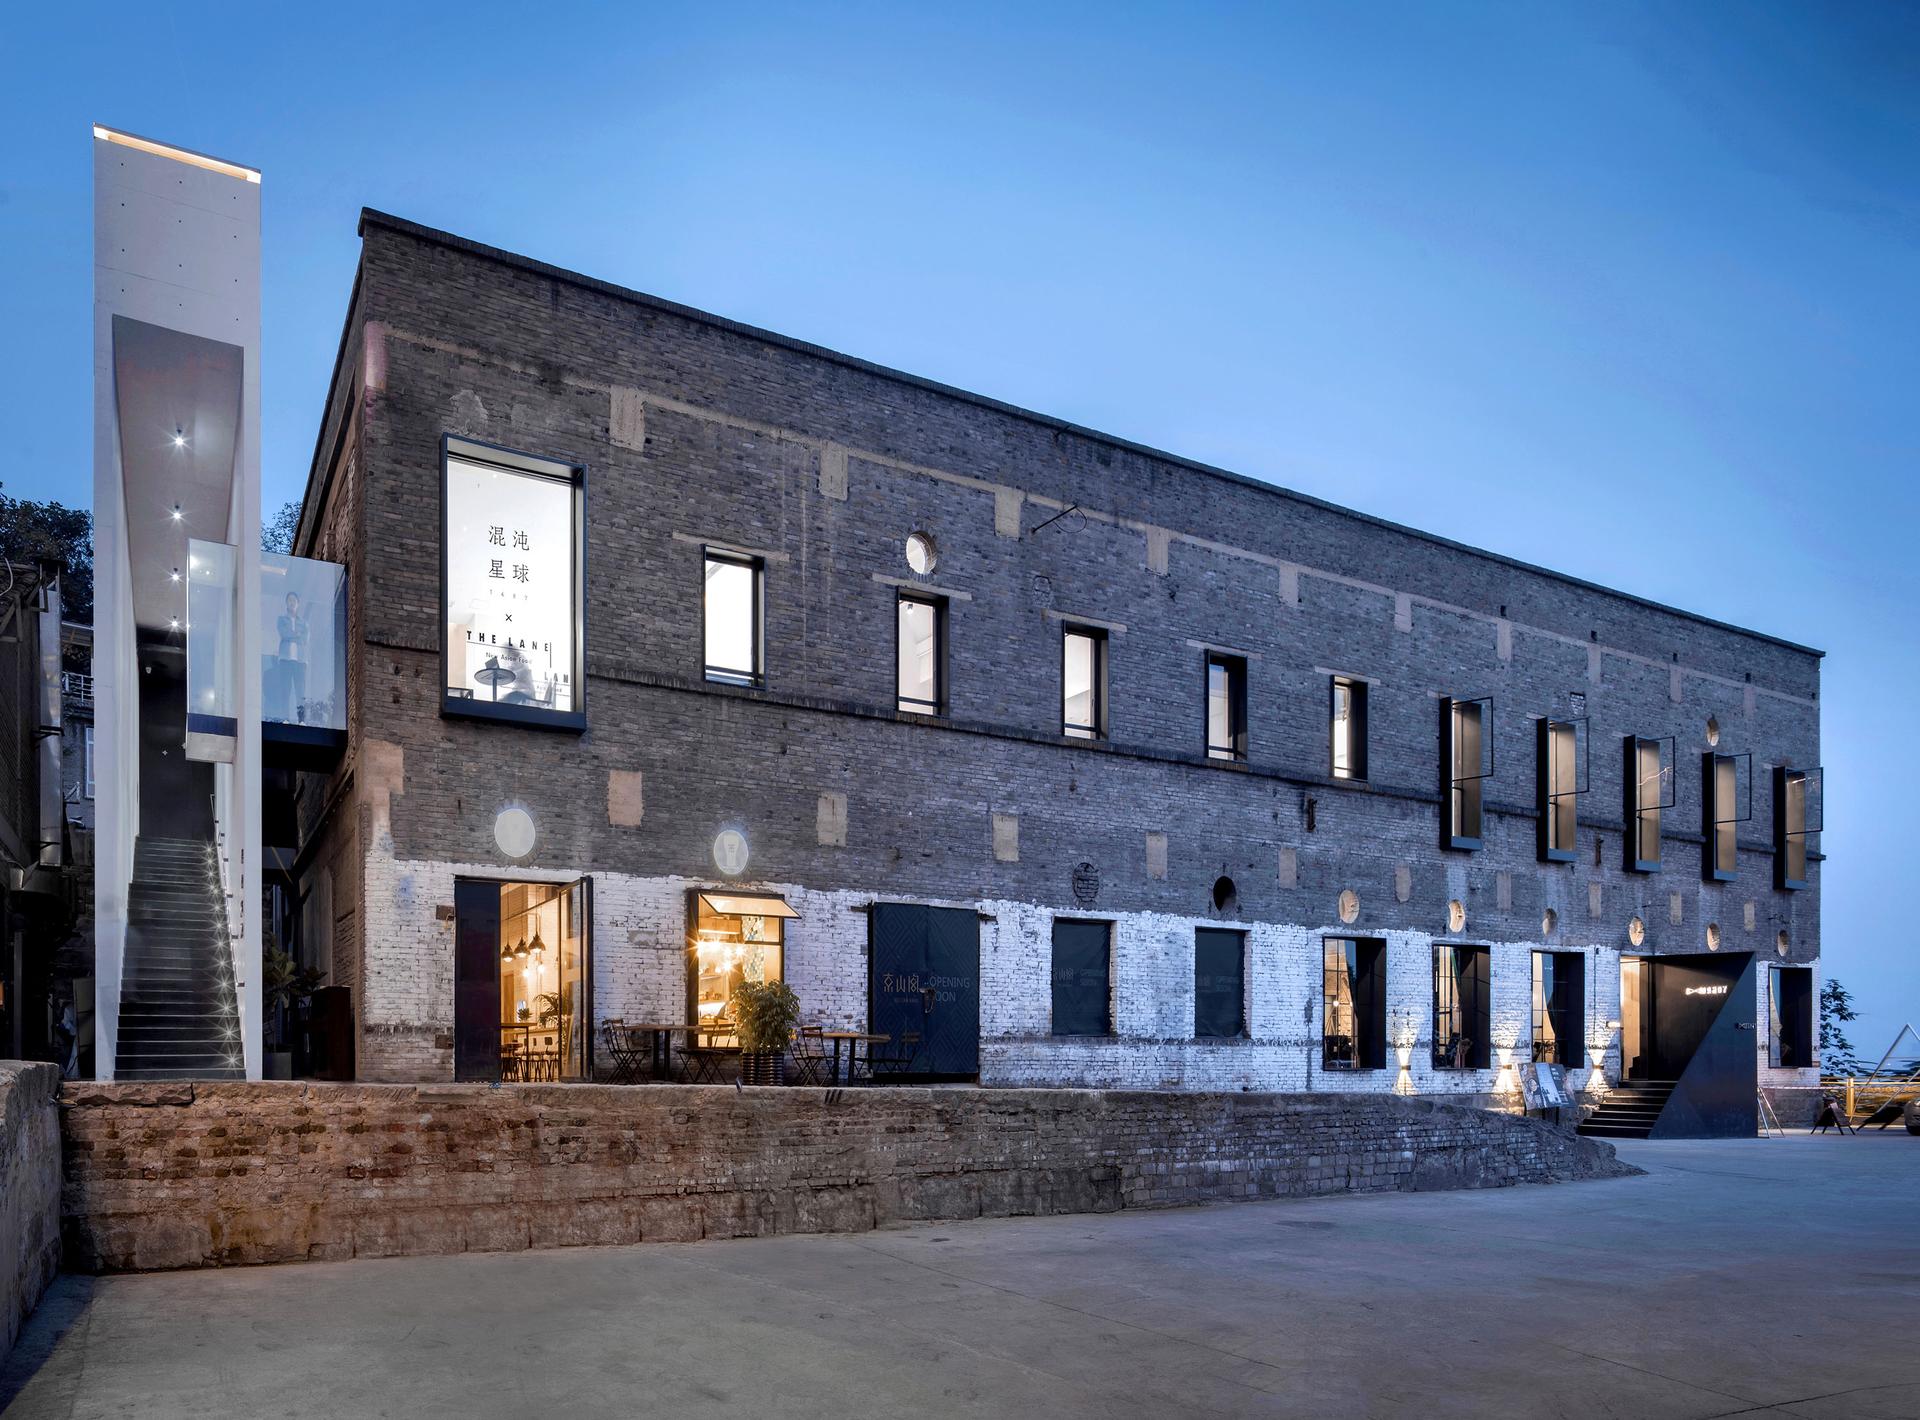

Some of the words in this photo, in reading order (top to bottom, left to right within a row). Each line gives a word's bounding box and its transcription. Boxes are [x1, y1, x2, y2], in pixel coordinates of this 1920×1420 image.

[488, 525, 530, 551] 混沌
[488, 559, 529, 583] 星球
[466, 630, 497, 644] THE
[508, 637, 549, 652] LANE
[929, 975, 970, 989] OPENING
[932, 991, 956, 1002] OON
